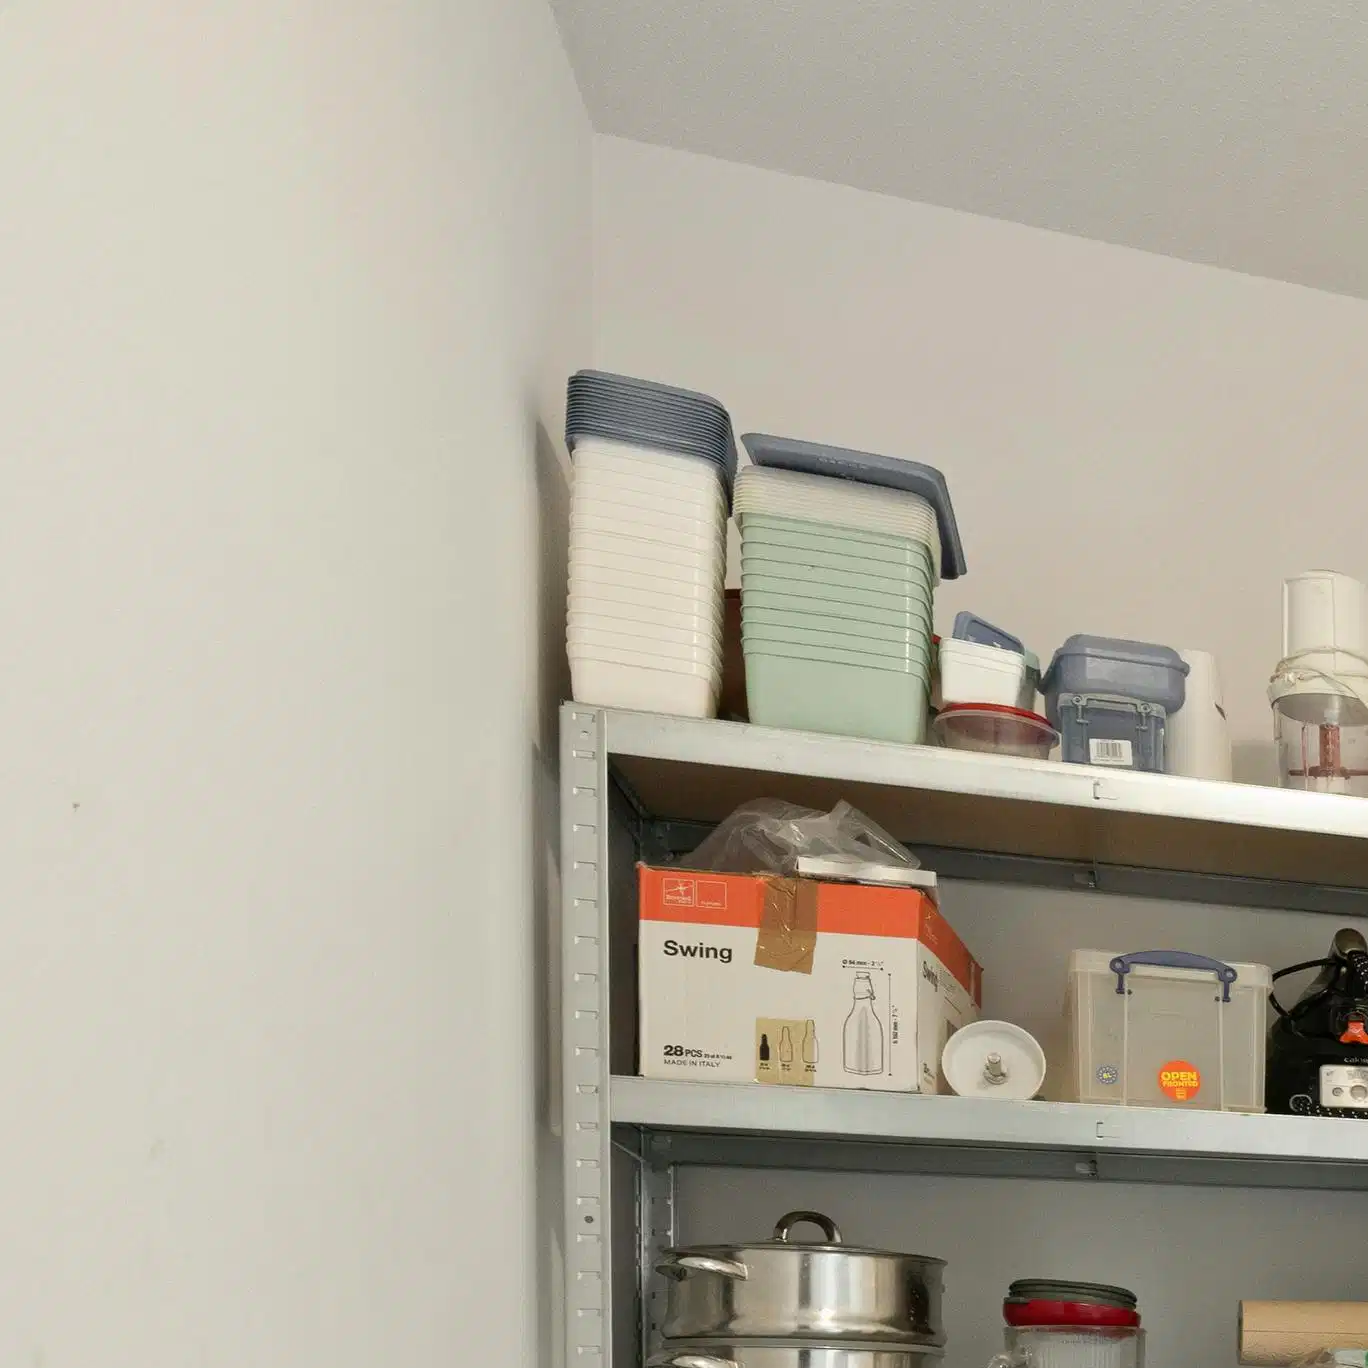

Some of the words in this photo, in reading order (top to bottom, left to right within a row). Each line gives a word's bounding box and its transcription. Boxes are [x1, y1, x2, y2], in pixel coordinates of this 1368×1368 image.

[663, 940, 733, 963] Swing
[663, 1045, 684, 1056] 28
[684, 1049, 703, 1057] PCS
[1161, 1072, 1197, 1081] OPEN
